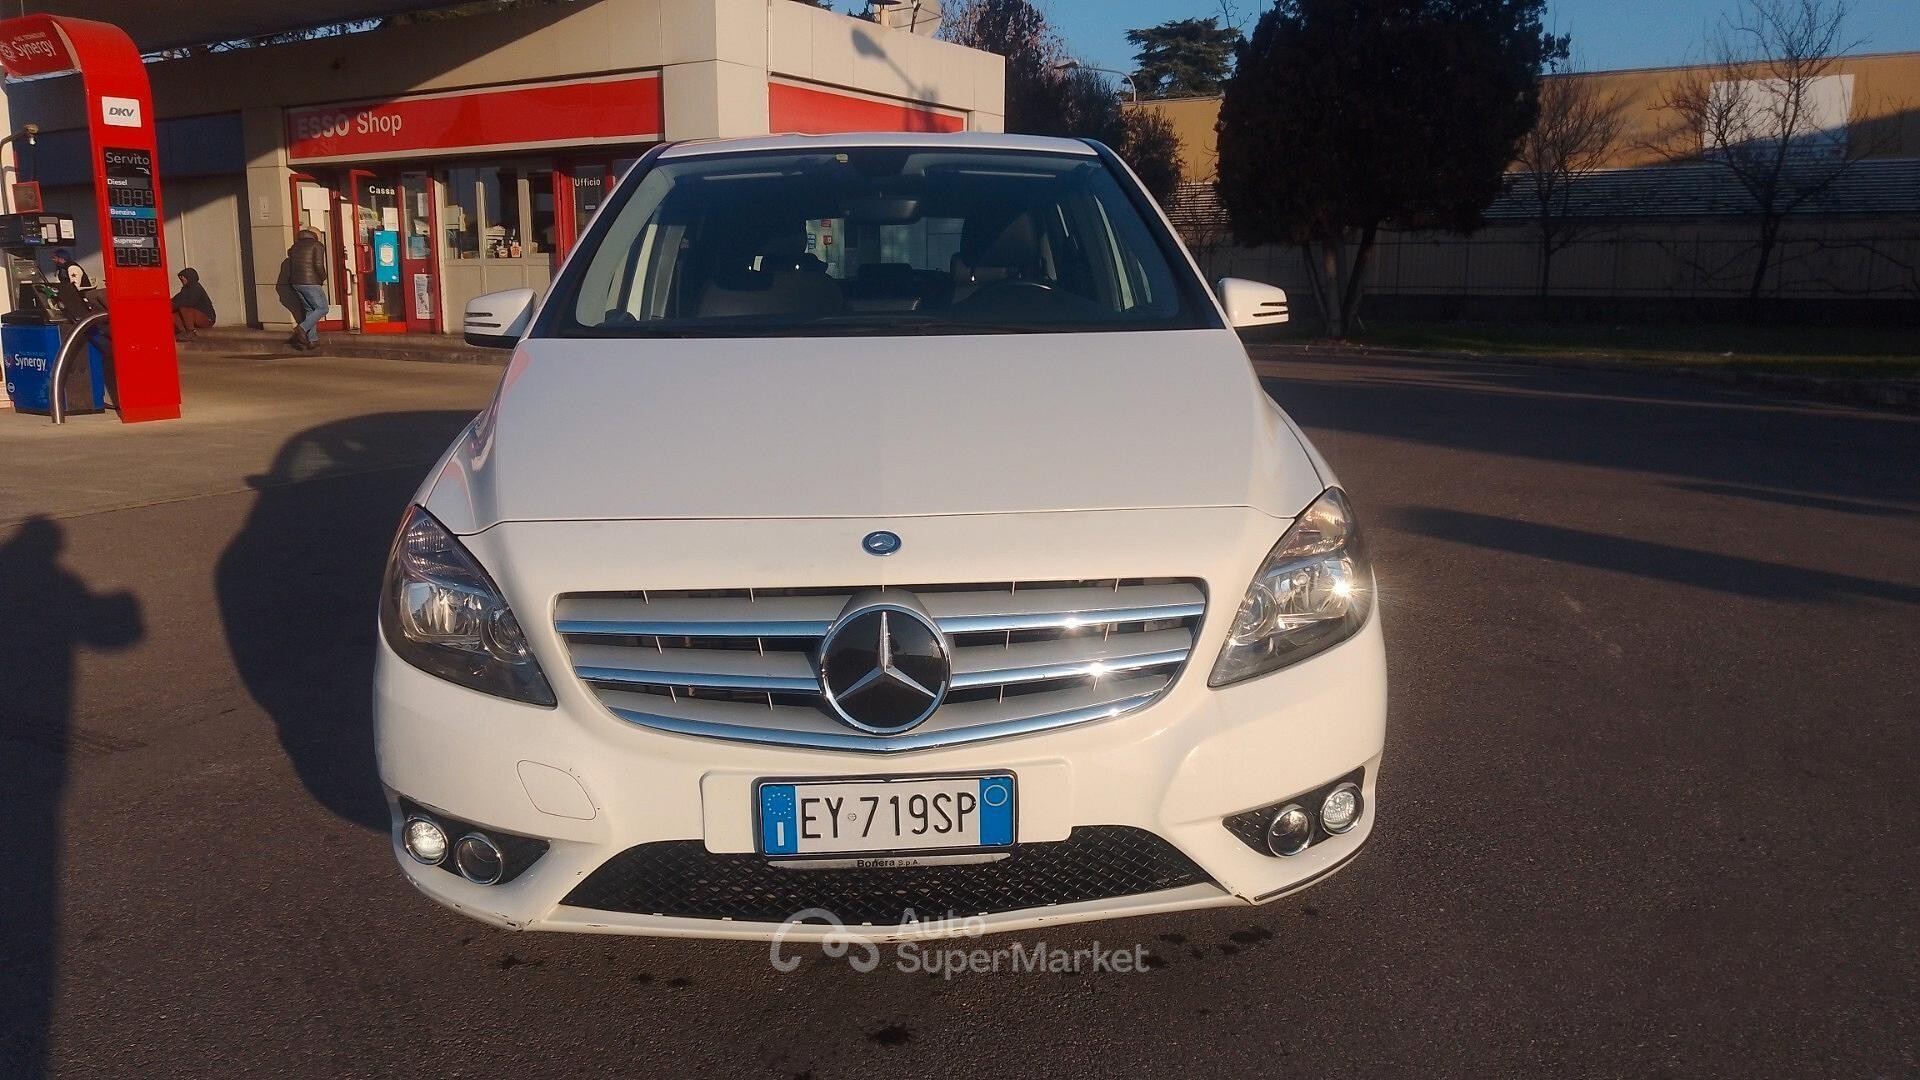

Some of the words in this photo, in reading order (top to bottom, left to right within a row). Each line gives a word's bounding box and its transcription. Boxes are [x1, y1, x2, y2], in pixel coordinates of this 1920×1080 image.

[11, 40, 57, 60] Synergy
[109, 107, 134, 117] DKV
[299, 113, 350, 139] ESSO
[356, 111, 402, 137] Shop
[105, 151, 150, 165] Servito
[107, 178, 128, 186] Diesel
[574, 177, 601, 187] Ufficio
[369, 186, 395, 196] Cassa
[110, 208, 136, 216] Benzina
[14, 353, 47, 371] Synergy
[801, 797, 844, 839] EY
[859, 791, 977, 838] 719SP
[857, 859, 895, 868] Bonera
